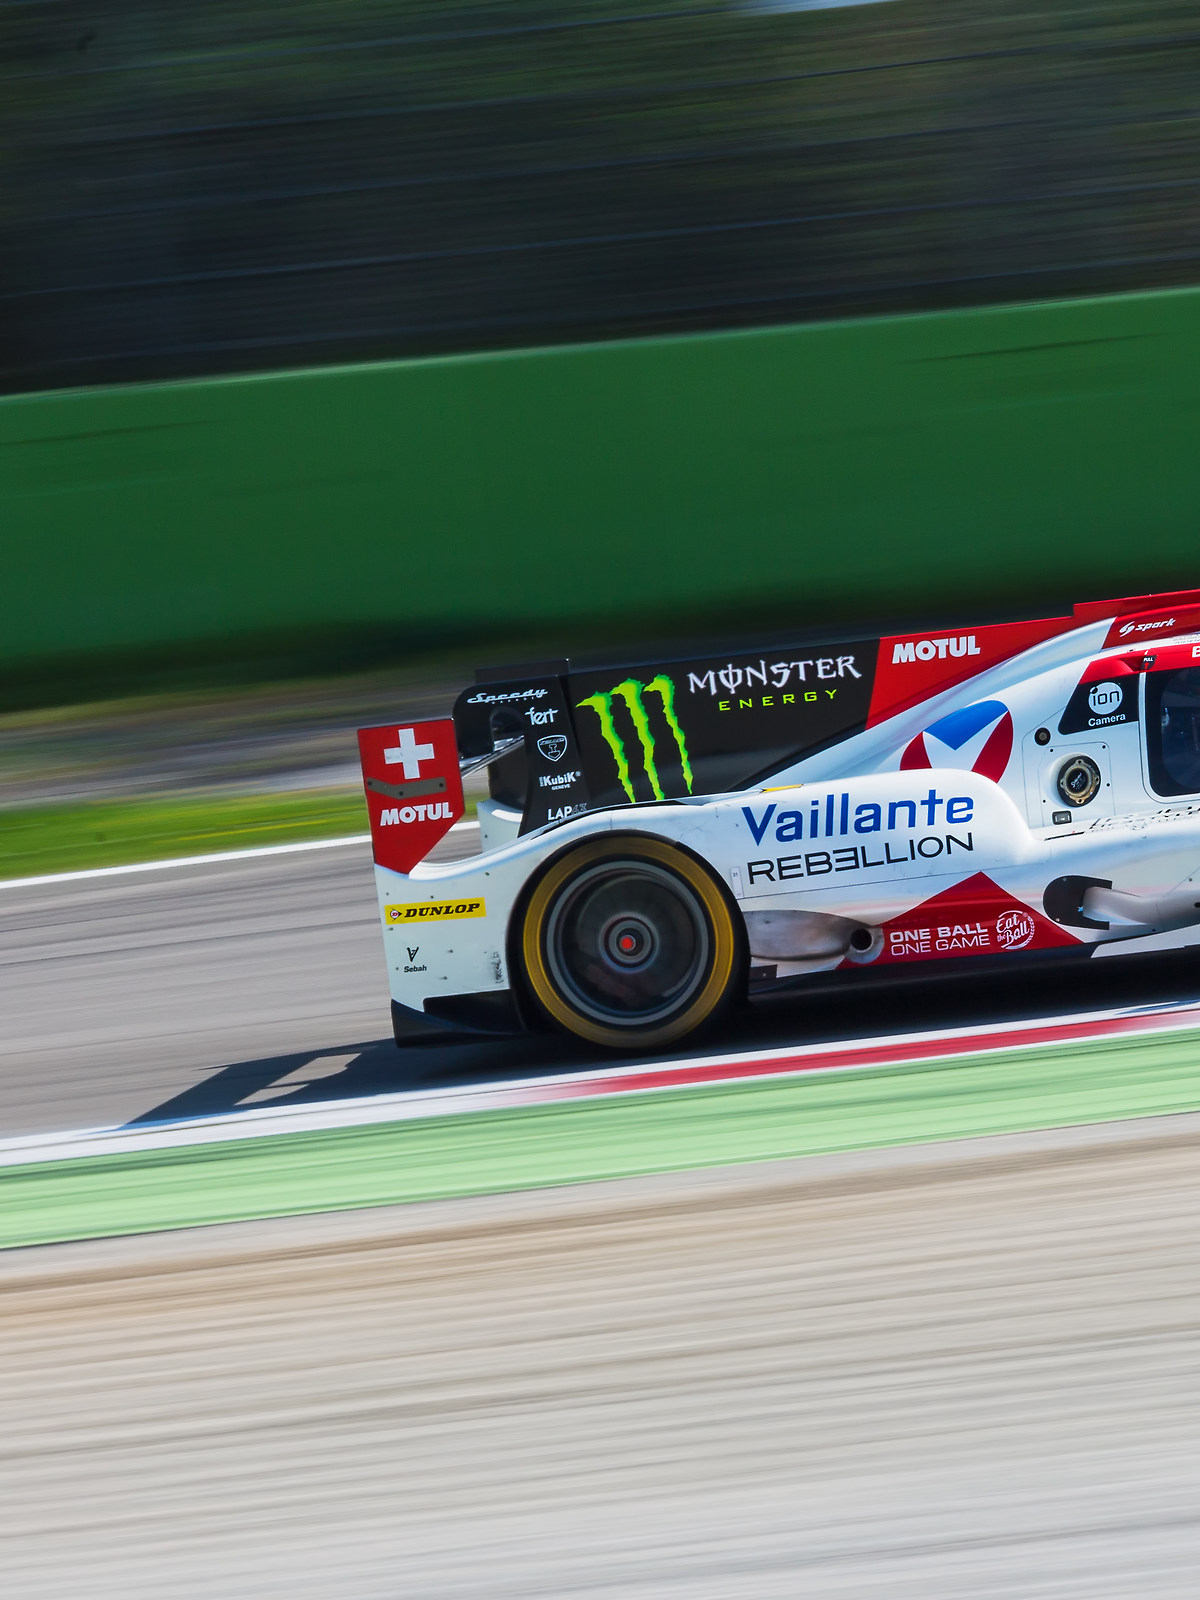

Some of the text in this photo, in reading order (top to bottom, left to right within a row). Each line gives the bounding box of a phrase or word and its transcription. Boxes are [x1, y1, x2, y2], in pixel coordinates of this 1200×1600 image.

[1135, 618, 1176, 632] spark
[892, 636, 981, 664] MOTUL
[687, 655, 862, 696] MONSTER
[467, 688, 548, 704] Speedy
[718, 689, 838, 711] ENERGY
[1090, 686, 1120, 707] ion
[525, 706, 559, 726] fert
[1088, 713, 1126, 727] Camera
[380, 801, 453, 826] MOTUL
[741, 789, 974, 846] Vaillante
[747, 832, 974, 885] REBELLION
[404, 903, 481, 918] DUNLOP
[889, 922, 988, 943] ONE BALL
[996, 913, 1021, 934] Eat
[1003, 920, 1030, 947] Ball
[891, 934, 991, 956] ONE GAME
[404, 965, 428, 973] Sebah
